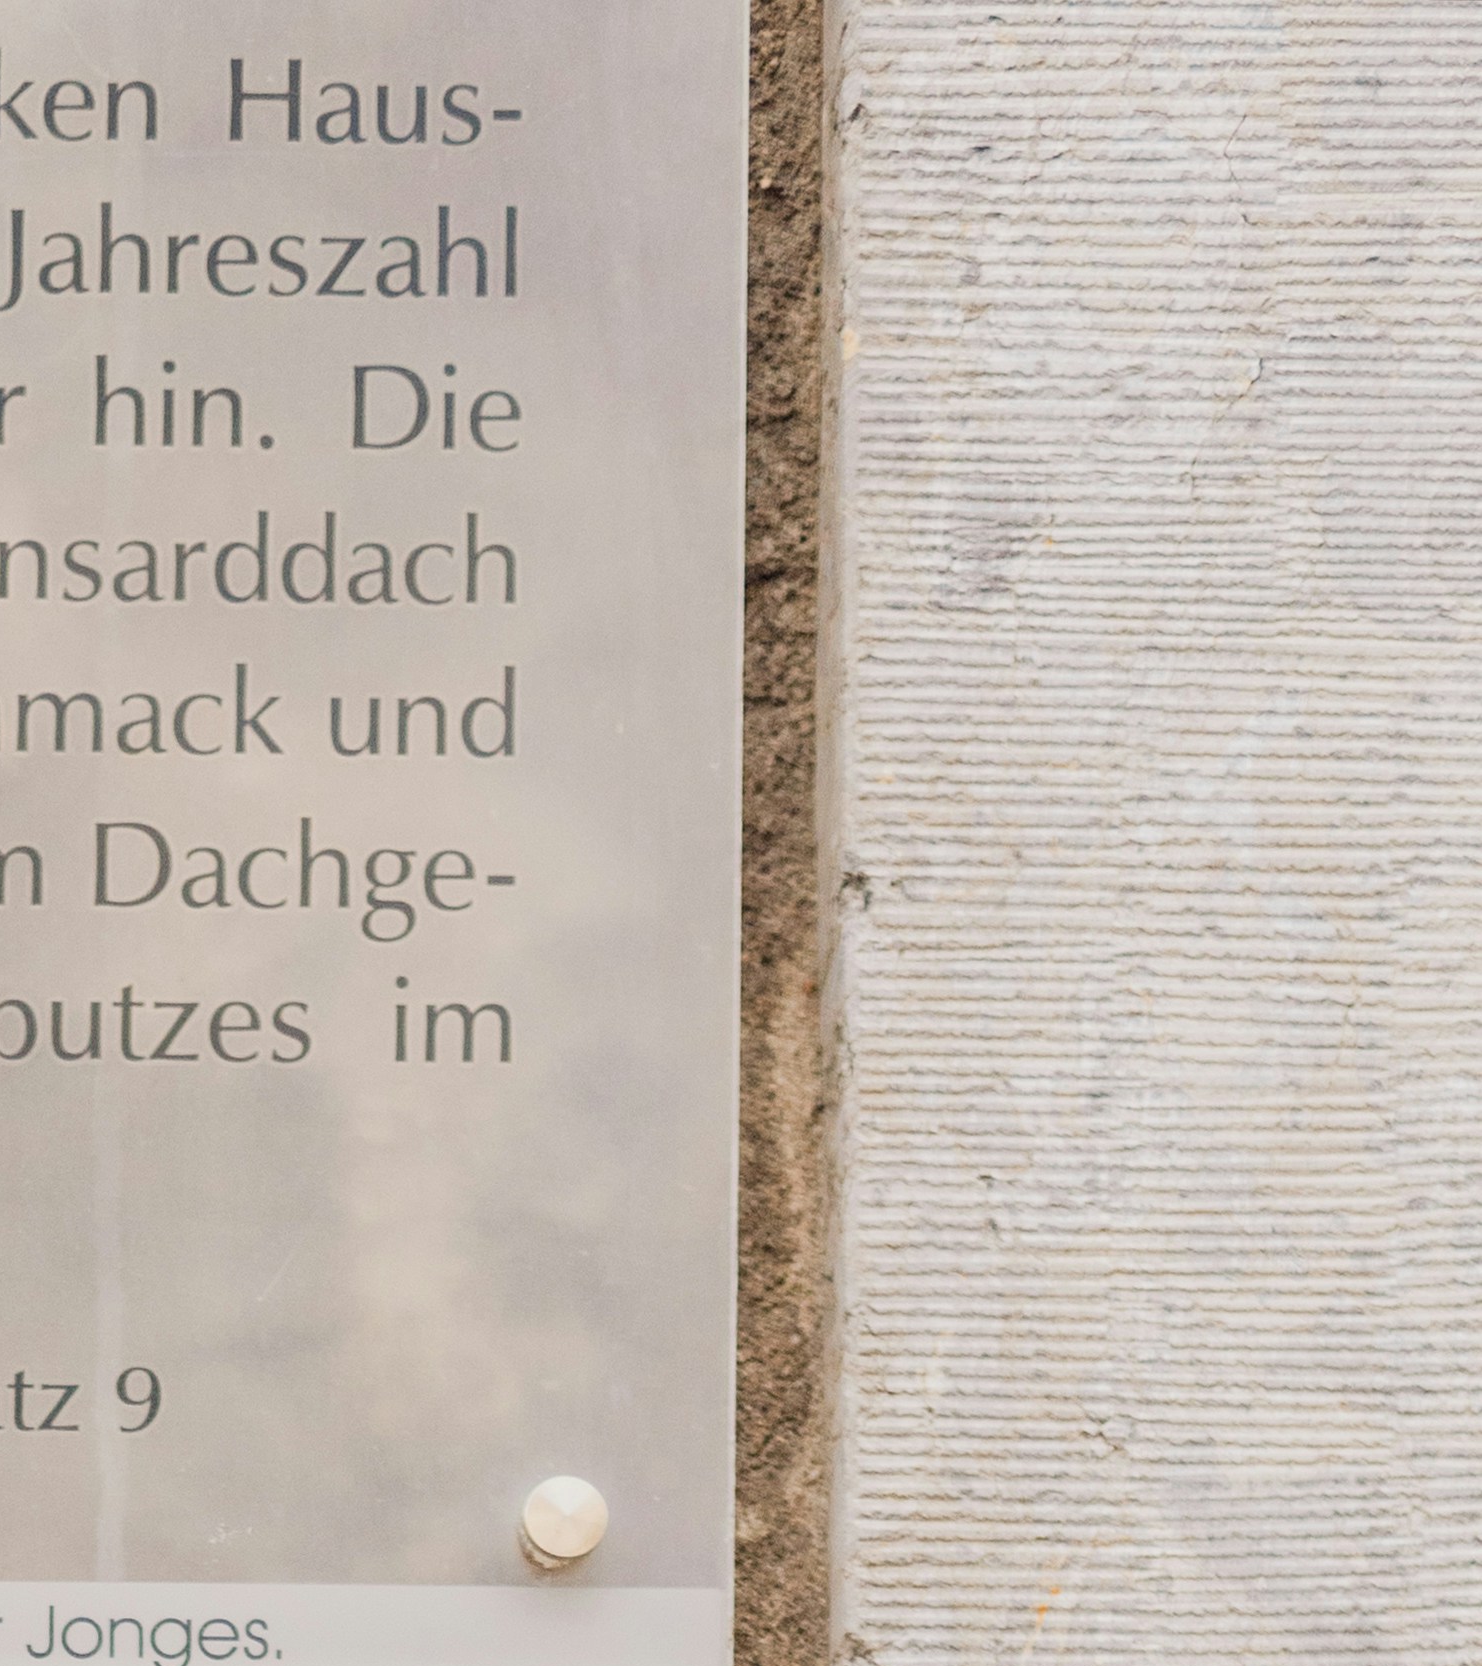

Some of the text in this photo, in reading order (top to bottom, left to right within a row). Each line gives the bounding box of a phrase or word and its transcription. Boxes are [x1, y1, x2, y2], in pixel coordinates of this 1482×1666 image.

[227, 56, 524, 148] Haus-
[93, 352, 276, 452] hin.
[350, 361, 523, 454] Die
[328, 664, 517, 760] und
[92, 815, 517, 944] Dachge-
[393, 974, 513, 1064] im
[114, 1365, 163, 1435] 9
